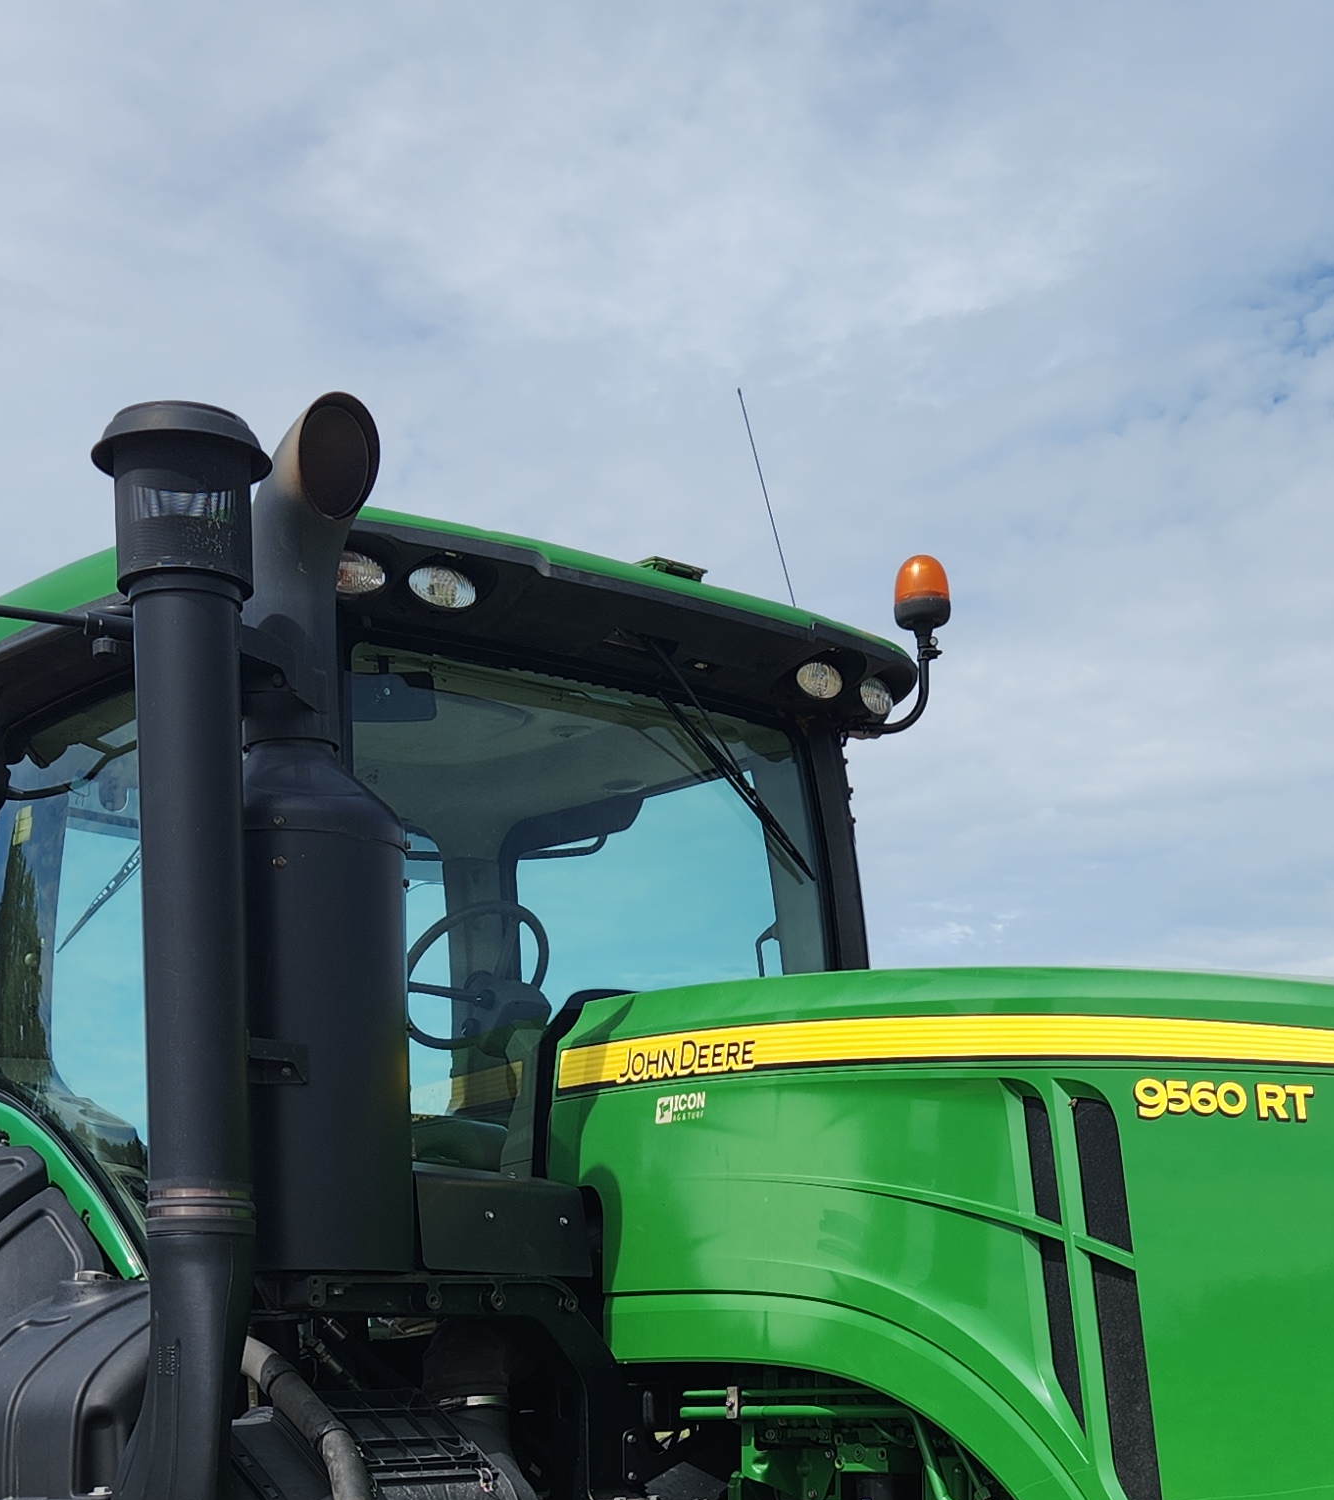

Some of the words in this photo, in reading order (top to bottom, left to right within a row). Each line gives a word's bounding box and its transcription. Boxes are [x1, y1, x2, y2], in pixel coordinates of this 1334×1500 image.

[619, 1046, 675, 1080] JOHN
[679, 1039, 756, 1073] DEERE
[672, 1091, 706, 1113] ICON
[1133, 1077, 1248, 1120] 9560
[1254, 1083, 1315, 1122] RT
